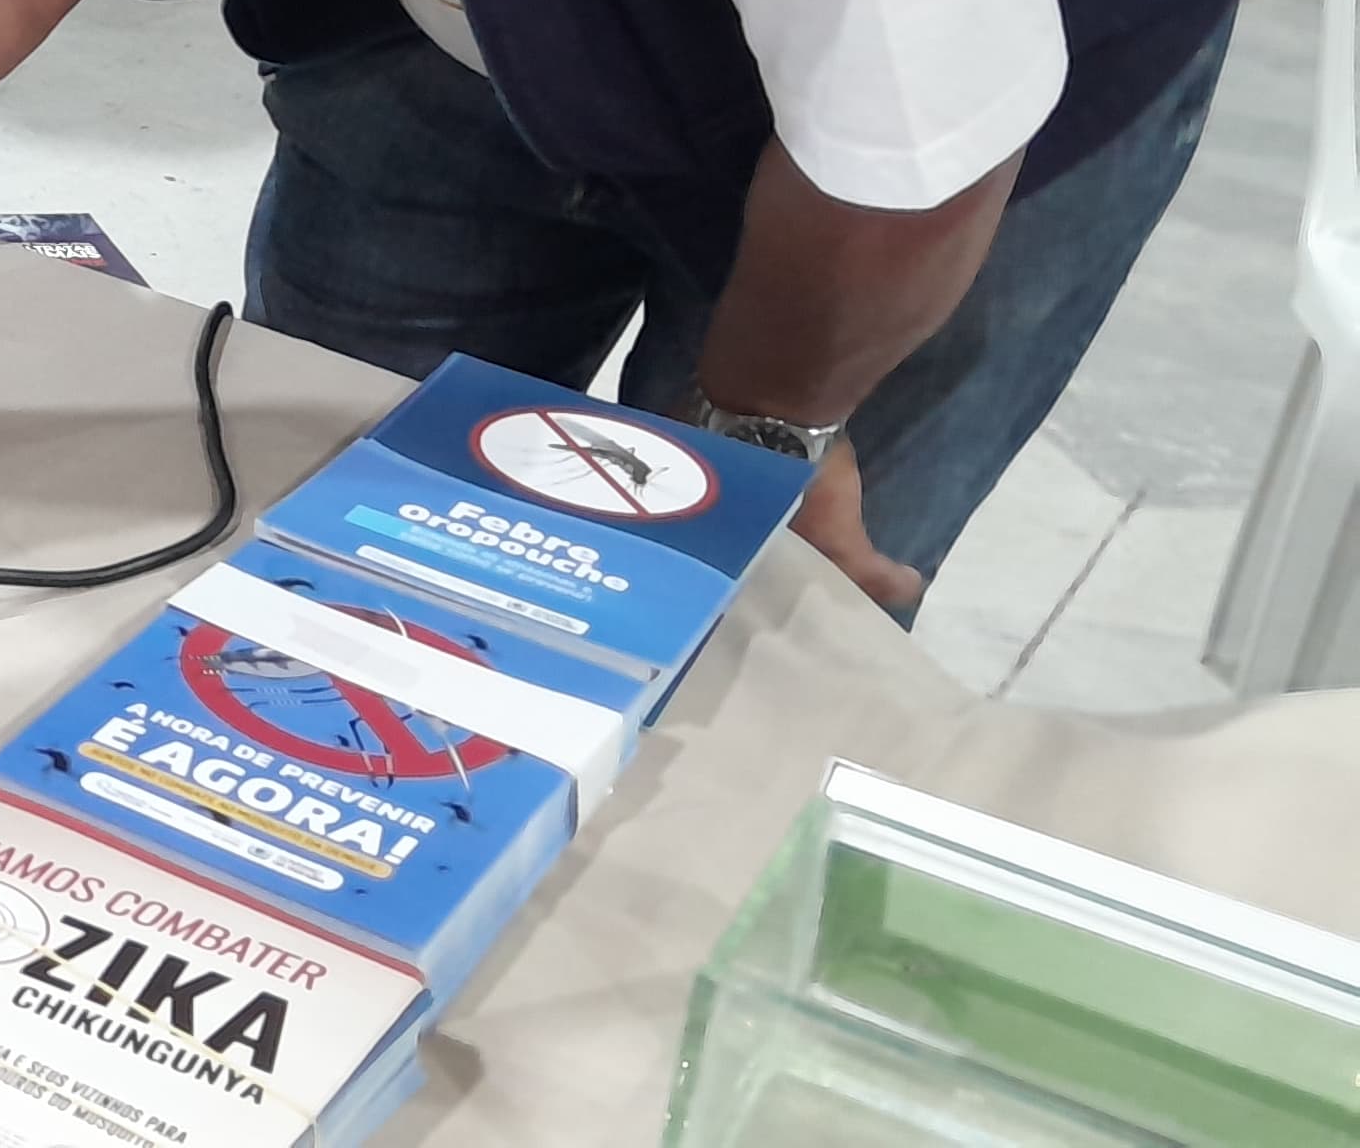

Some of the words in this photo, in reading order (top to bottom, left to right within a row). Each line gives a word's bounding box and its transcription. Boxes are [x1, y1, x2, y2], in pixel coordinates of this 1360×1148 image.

[398, 503, 629, 592] oropouche
[448, 501, 599, 563] Febre
[91, 716, 148, 753] É
[138, 741, 420, 866] AGORA!
[124, 703, 148, 718] A
[149, 710, 230, 751] HORA
[232, 744, 275, 769] DE
[278, 763, 436, 834] PREVENIR
[20, 914, 290, 1074] ZIKA
[105, 890, 327, 990] COMBATER
[11, 985, 265, 1105] CHIKUNGUNYA
[13, 1053, 28, 1068] E
[26, 1060, 70, 1088] SEUS
[70, 1080, 145, 1124] VIZINHOS
[145, 1115, 189, 1145] PARA
